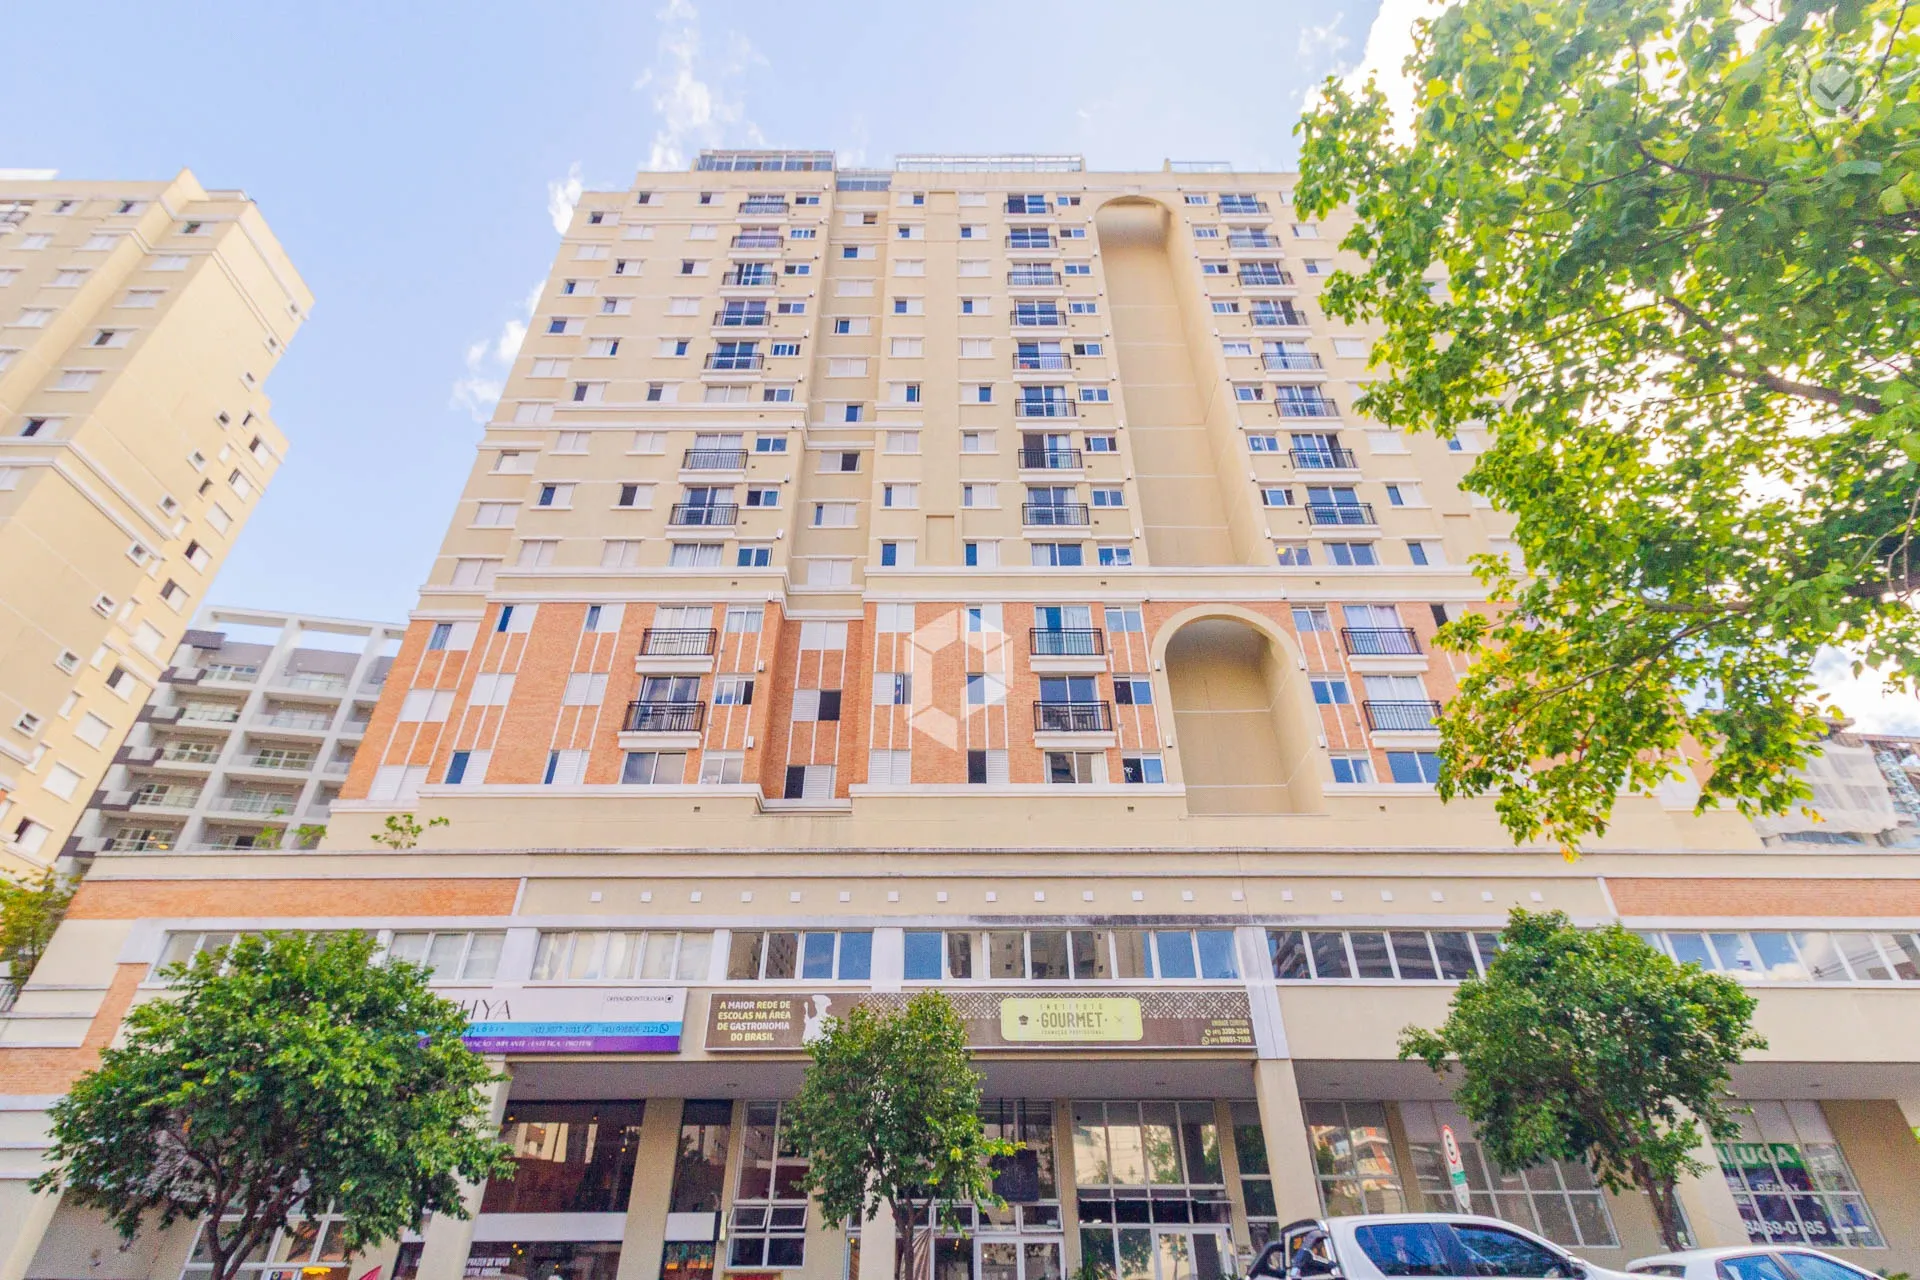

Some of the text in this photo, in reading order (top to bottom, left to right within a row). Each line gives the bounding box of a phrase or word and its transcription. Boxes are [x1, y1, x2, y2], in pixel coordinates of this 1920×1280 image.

[720, 1001, 791, 1009] A MAIOR REDE DE
[718, 1011, 754, 1020] ESCOLAS
[768, 1010, 791, 1019] ÁREA
[1040, 1012, 1103, 1028] GOURMET
[717, 1021, 790, 1031] DE GASTRONOMIA
[730, 1032, 775, 1041] DO BRASIL
